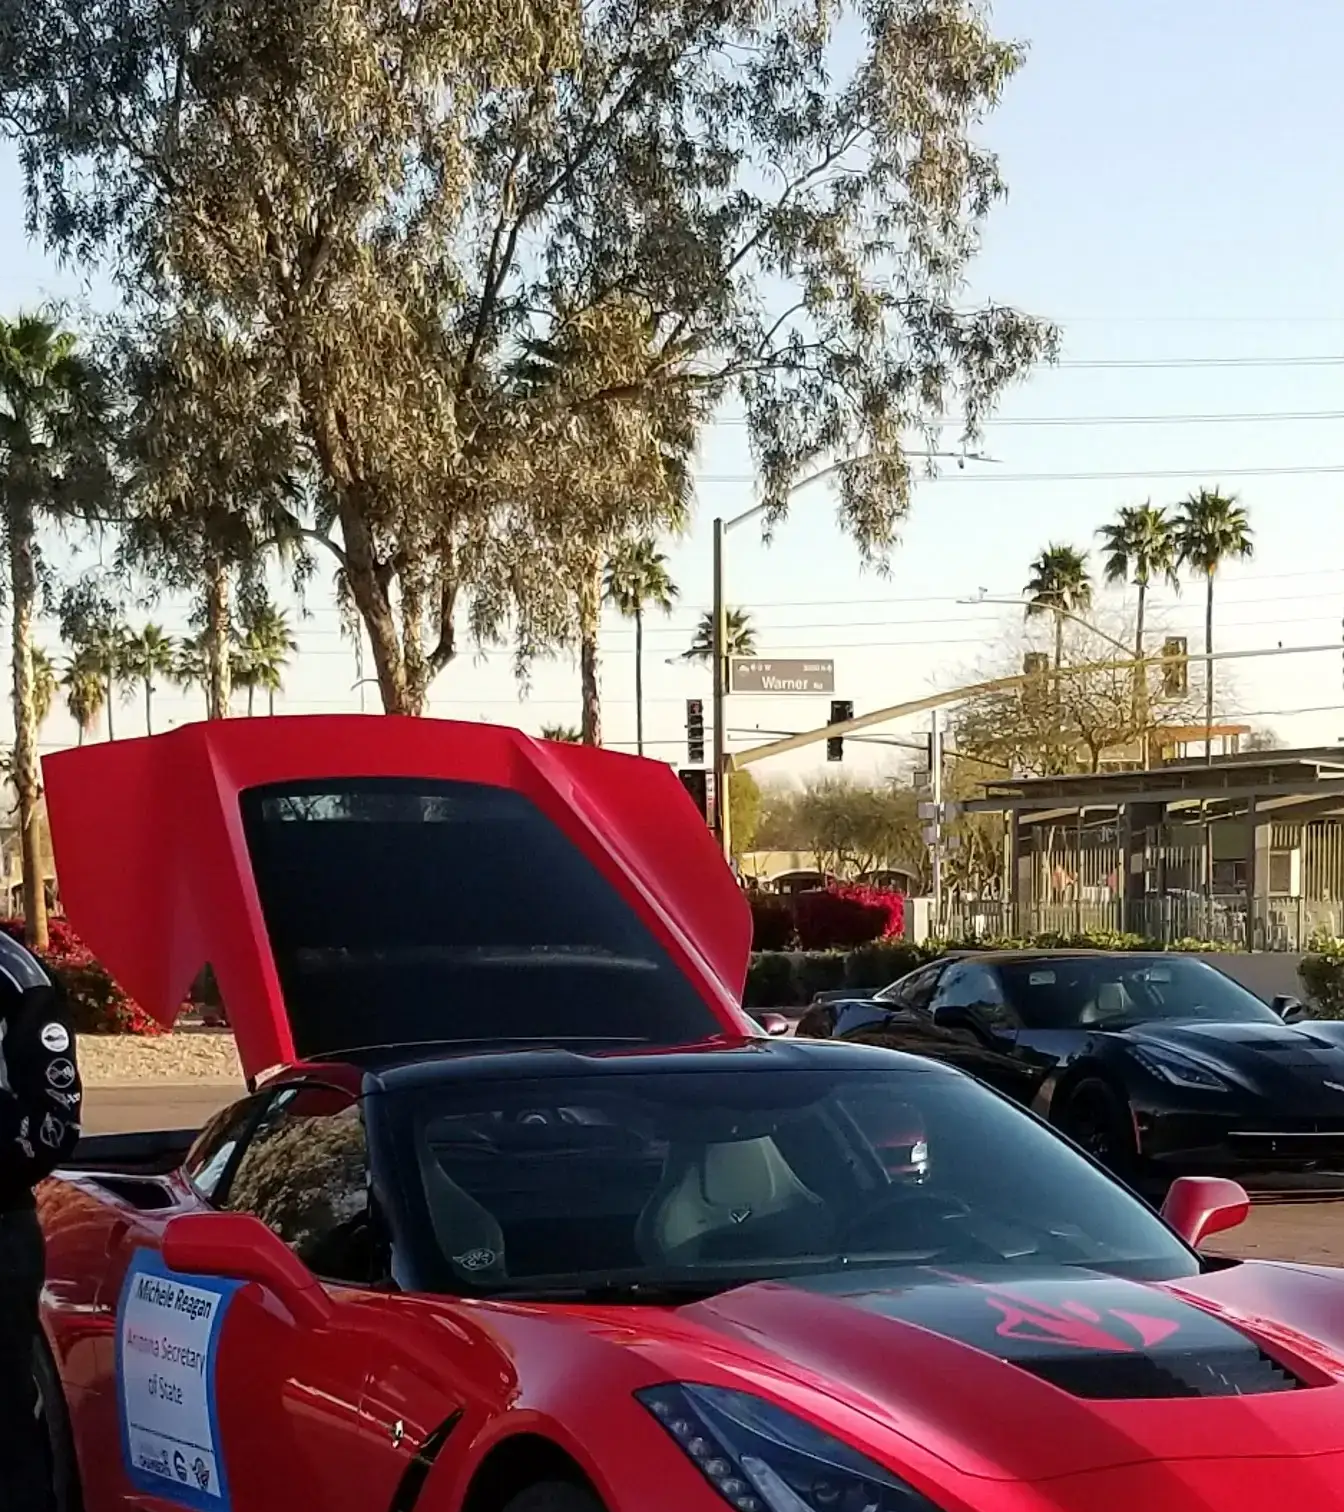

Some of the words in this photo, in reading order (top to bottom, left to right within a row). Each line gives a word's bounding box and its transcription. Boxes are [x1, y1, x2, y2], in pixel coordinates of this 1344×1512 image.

[761, 675, 809, 690] Warner
[136, 1277, 174, 1310] Michele
[174, 1287, 212, 1321] Reagan
[160, 1336, 206, 1379] Secretary
[158, 1376, 183, 1406] State
